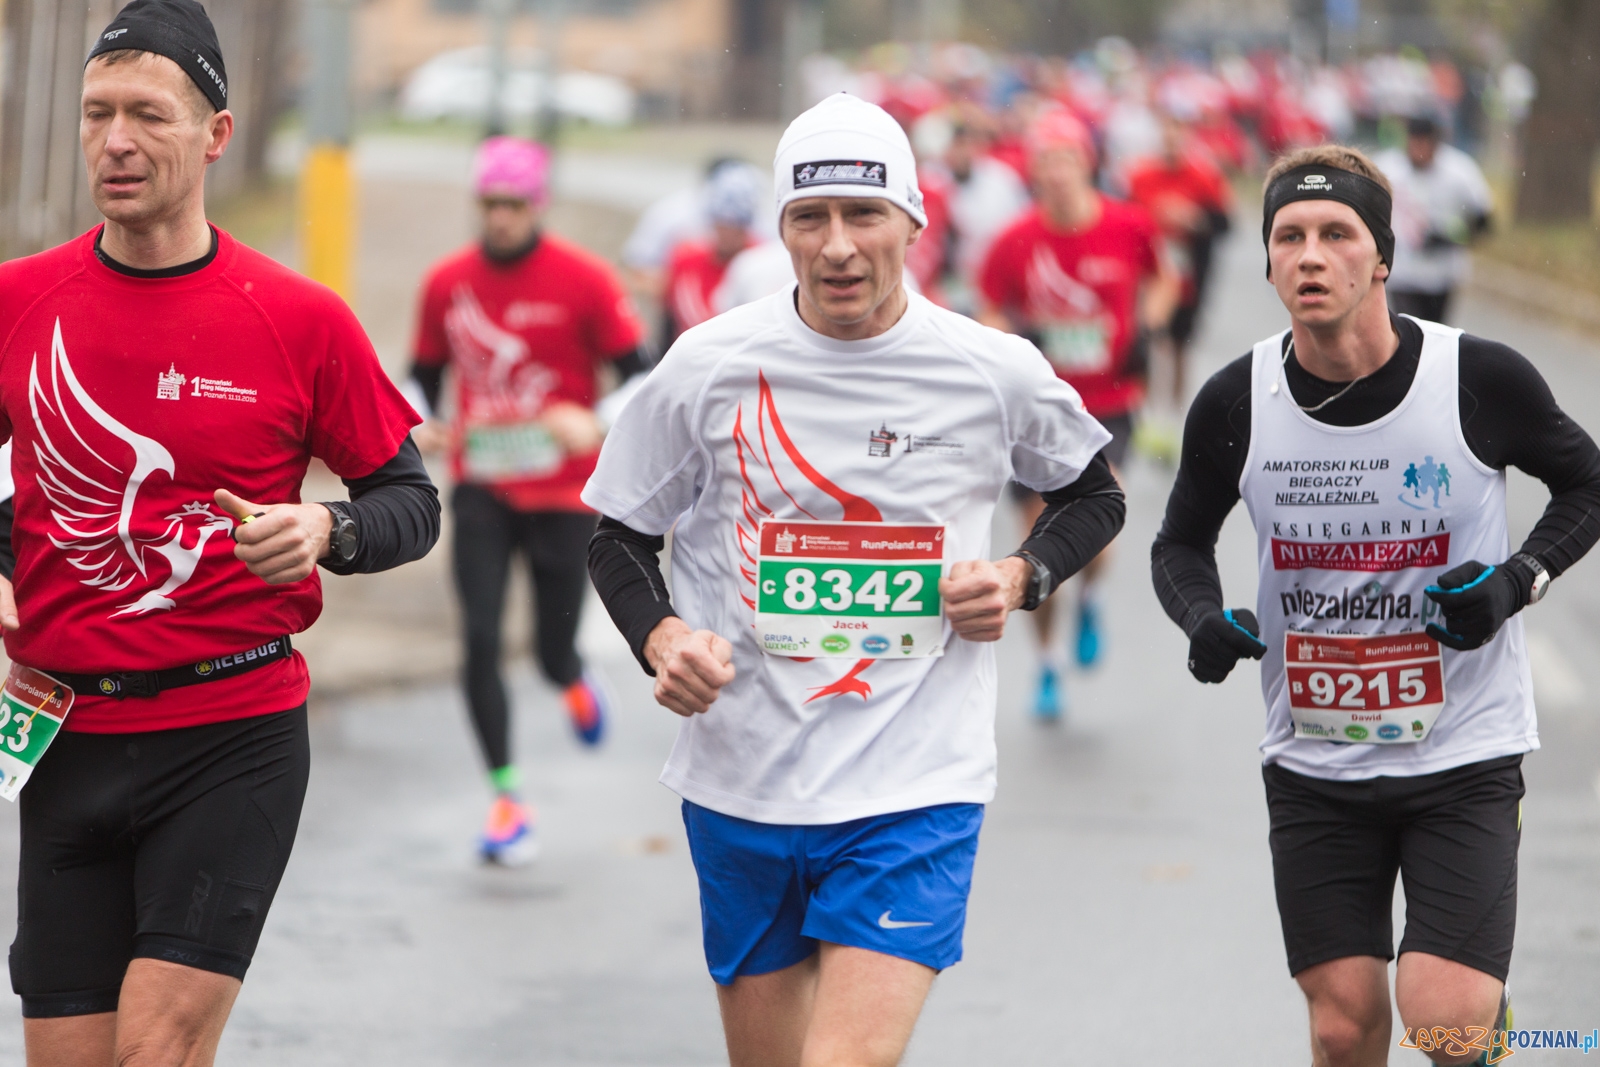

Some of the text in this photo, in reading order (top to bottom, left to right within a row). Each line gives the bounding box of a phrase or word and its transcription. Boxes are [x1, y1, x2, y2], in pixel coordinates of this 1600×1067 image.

[197, 53, 227, 98] TERVEL
[191, 376, 202, 397] 1
[1262, 459, 1390, 472] AMATORSKI KLUB
[1289, 475, 1363, 488] BIEGACZY
[1275, 489, 1379, 505] NIEZALEŻNI.PL
[1273, 518, 1446, 539] KSIĘGARNIA
[800, 534, 808, 550] 1
[861, 540, 933, 552] RunPoland.org
[1280, 540, 1439, 562] NIEZALEŻNA
[782, 567, 924, 613] 8342
[833, 620, 869, 631] Jacek
[764, 633, 793, 643] GRUPA
[764, 642, 798, 651] LUXMED
[1365, 642, 1429, 657] RunPoland.org
[1292, 667, 1427, 708] B 9215
[1351, 713, 1382, 722] Dawid
